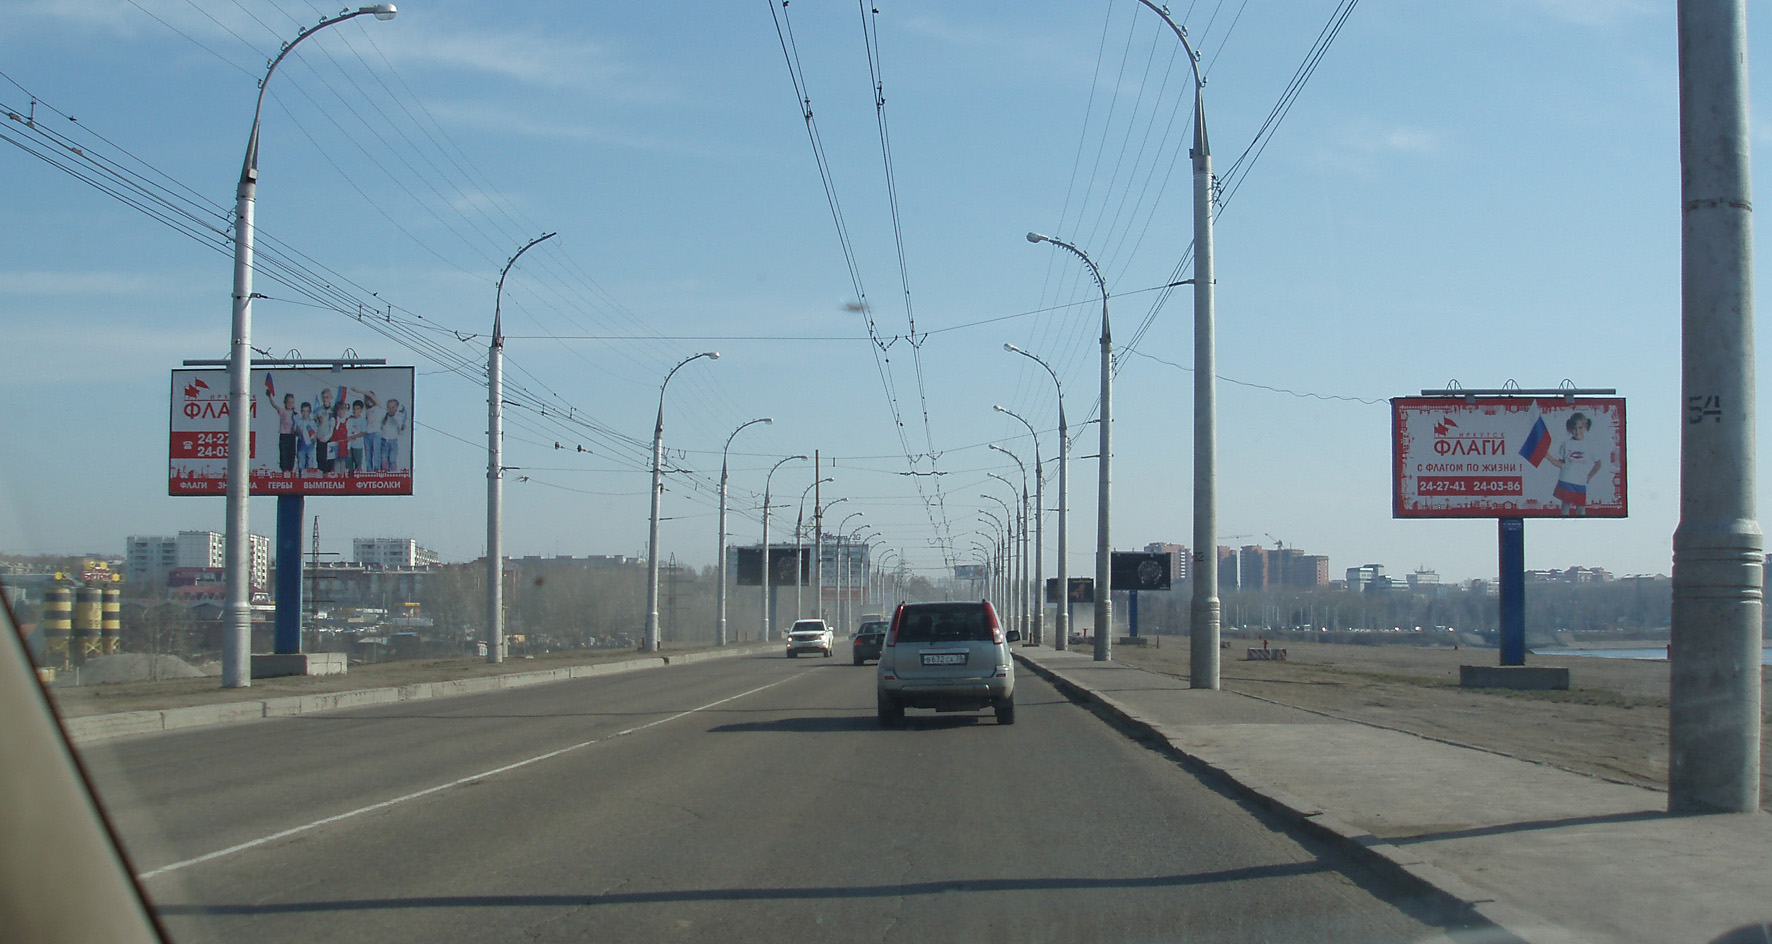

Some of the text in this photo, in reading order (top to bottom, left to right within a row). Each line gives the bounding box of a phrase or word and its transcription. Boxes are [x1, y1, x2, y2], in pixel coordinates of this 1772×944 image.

[183, 402, 257, 419] ФЛАИ
[1689, 395, 1722, 424] 54
[1434, 439, 1505, 456] ФЛАГИ
[1417, 464, 1423, 472] С
[1425, 463, 1463, 472] ФЛАГОМ
[1466, 464, 1479, 472] ПО
[1482, 464, 1516, 472] ЖИЗНИ
[180, 481, 208, 489] ФЛАГИ
[268, 481, 293, 489] ГЕРБЫ
[303, 481, 345, 489] ВЫМПЕЛЫ
[355, 481, 401, 489] ФУТБОЛКИ
[1420, 481, 1521, 491] 24-27-41 24-03-86
